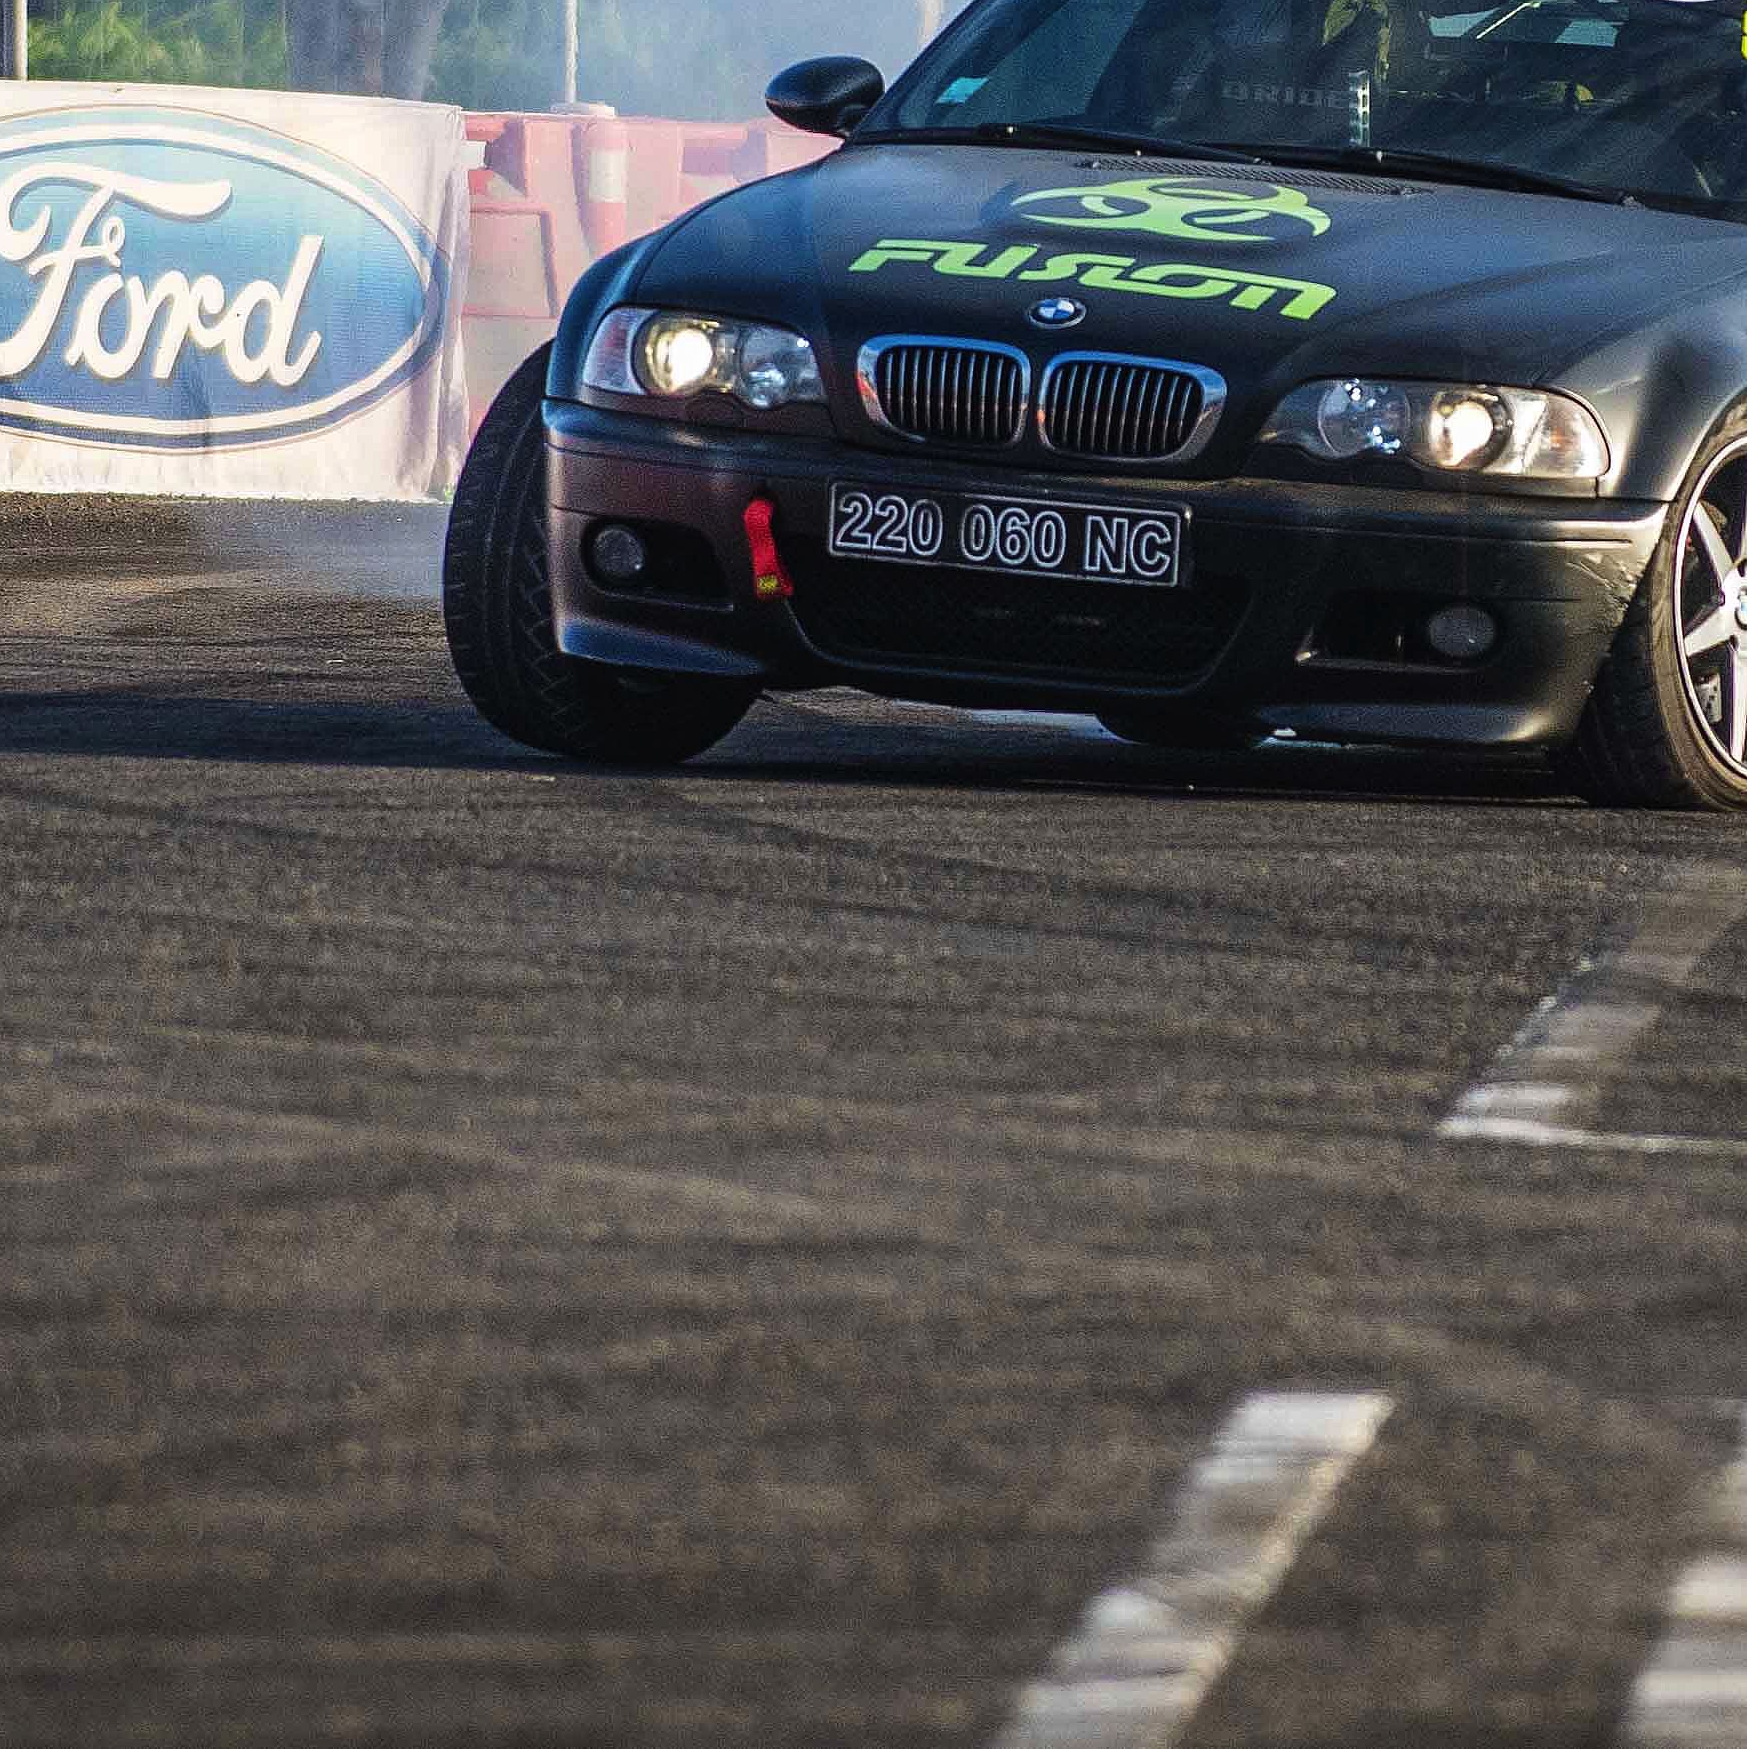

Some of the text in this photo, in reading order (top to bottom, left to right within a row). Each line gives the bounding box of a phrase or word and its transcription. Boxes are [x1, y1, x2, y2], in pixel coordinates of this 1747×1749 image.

[836, 491, 1171, 576] 220 060 NC
